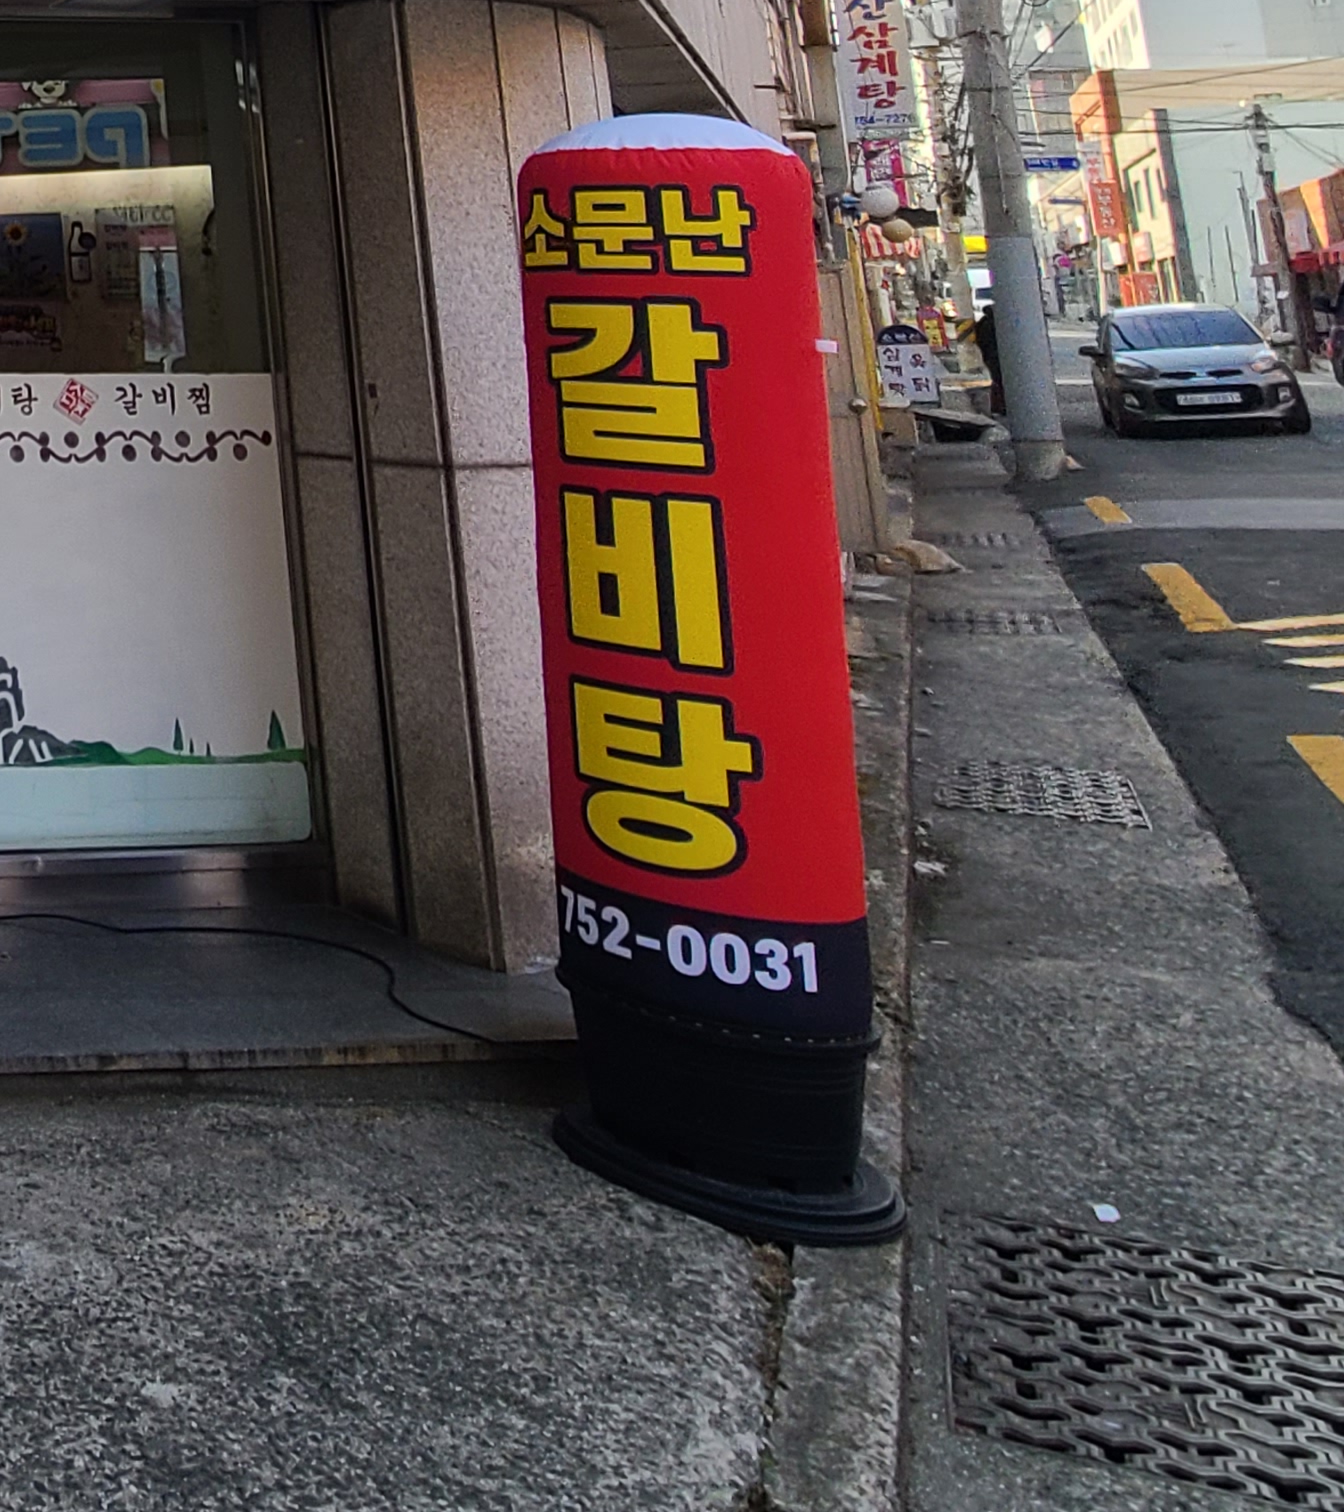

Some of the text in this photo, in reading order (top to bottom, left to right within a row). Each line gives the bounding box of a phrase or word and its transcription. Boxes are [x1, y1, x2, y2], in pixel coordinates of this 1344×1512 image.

[524, 189, 751, 273] 소문난
[114, 382, 213, 416] 갈비찜
[549, 302, 753, 871] 갈비탕
[561, 885, 818, 994] 752-0031
